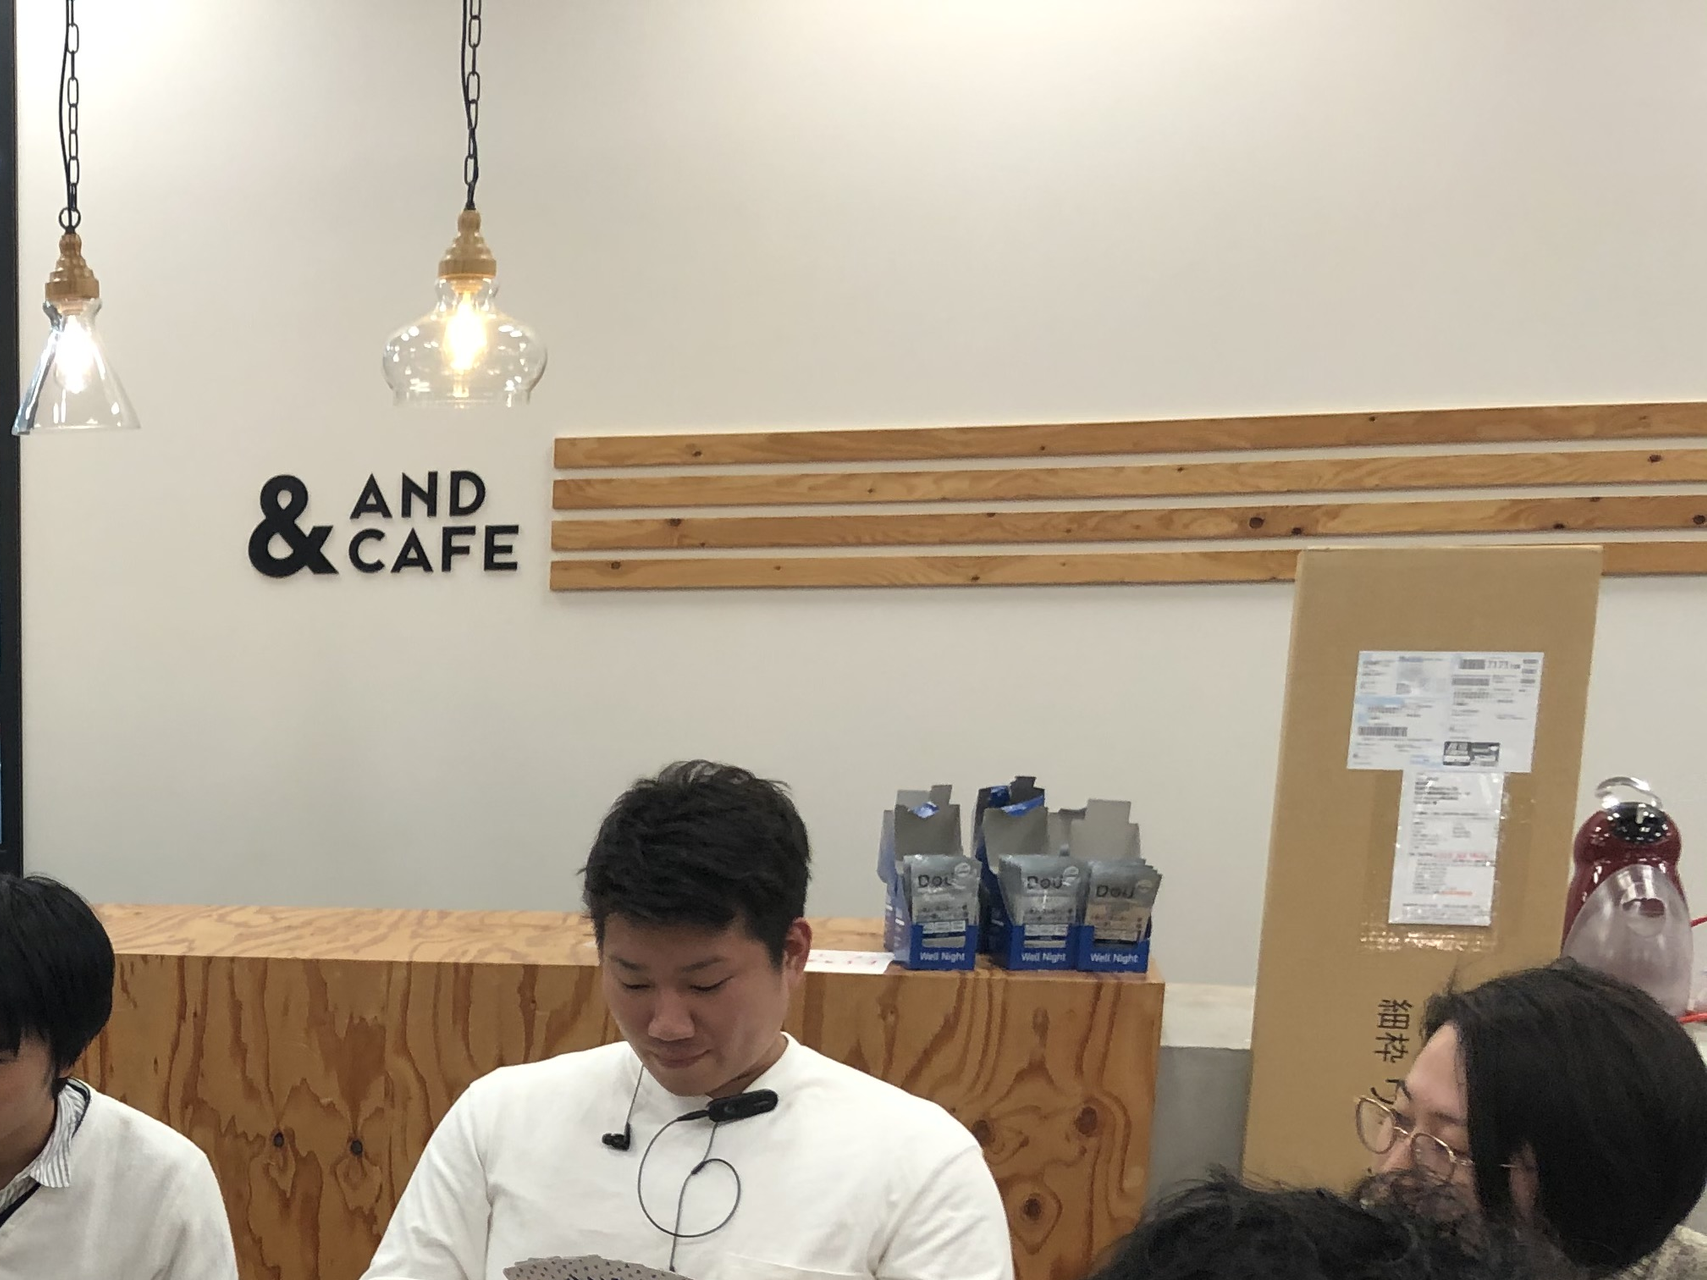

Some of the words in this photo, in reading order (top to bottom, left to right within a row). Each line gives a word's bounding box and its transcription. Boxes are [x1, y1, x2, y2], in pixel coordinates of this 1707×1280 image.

[247, 474, 339, 578] &
[349, 470, 486, 519] AND
[348, 524, 519, 573] CAFE
